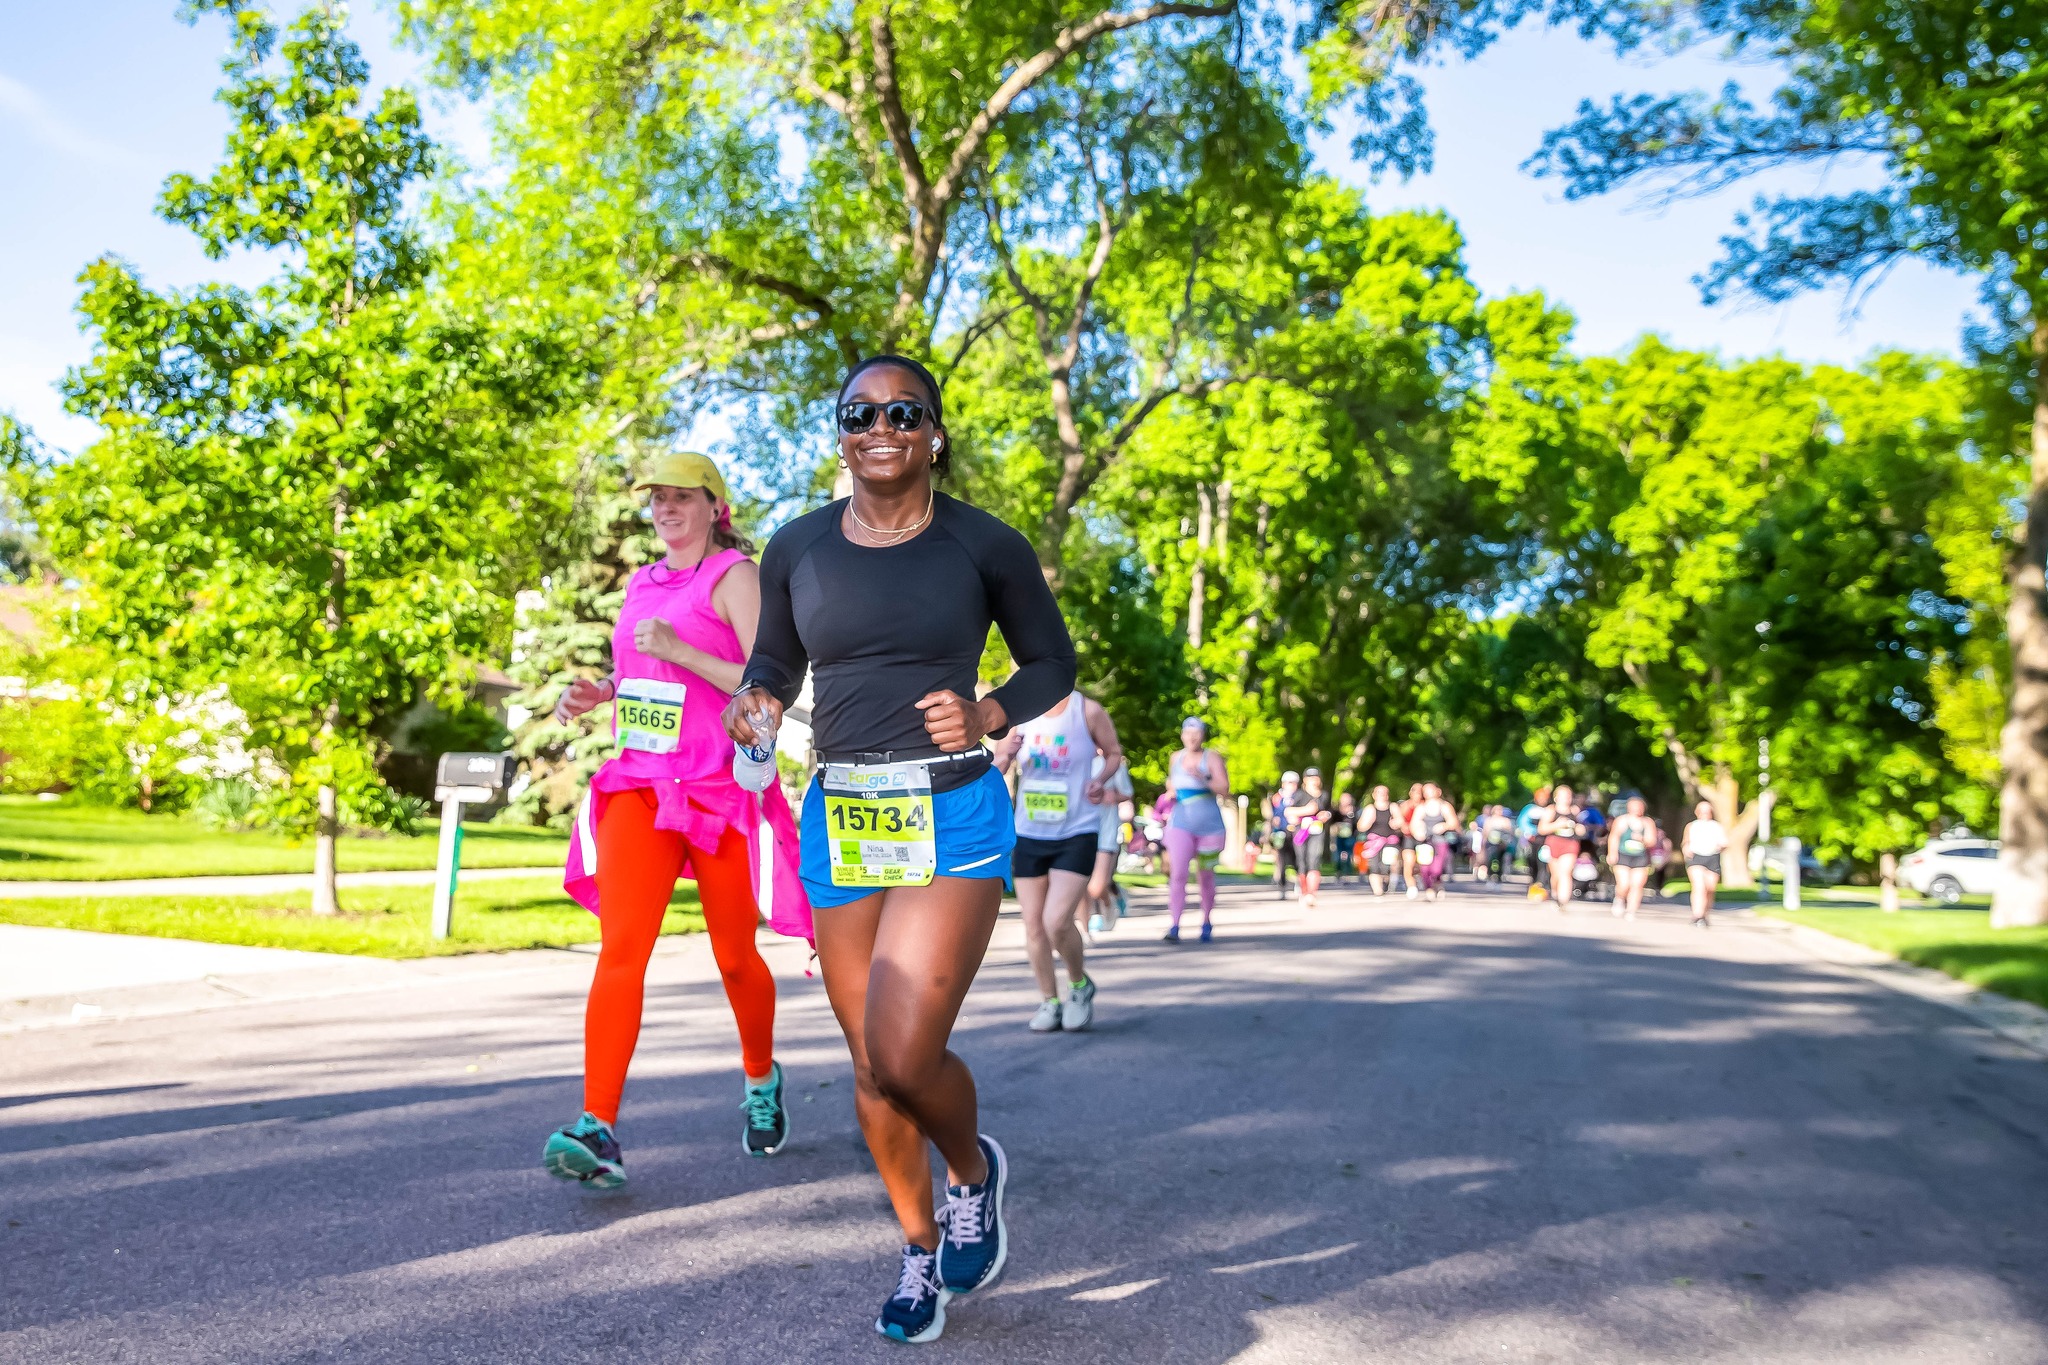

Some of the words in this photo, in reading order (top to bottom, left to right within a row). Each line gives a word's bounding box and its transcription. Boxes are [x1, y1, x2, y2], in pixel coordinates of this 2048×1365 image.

[620, 705, 677, 730] 15665
[848, 772, 889, 789] Fargo
[861, 791, 879, 799] 10K
[832, 804, 928, 833] 15734
